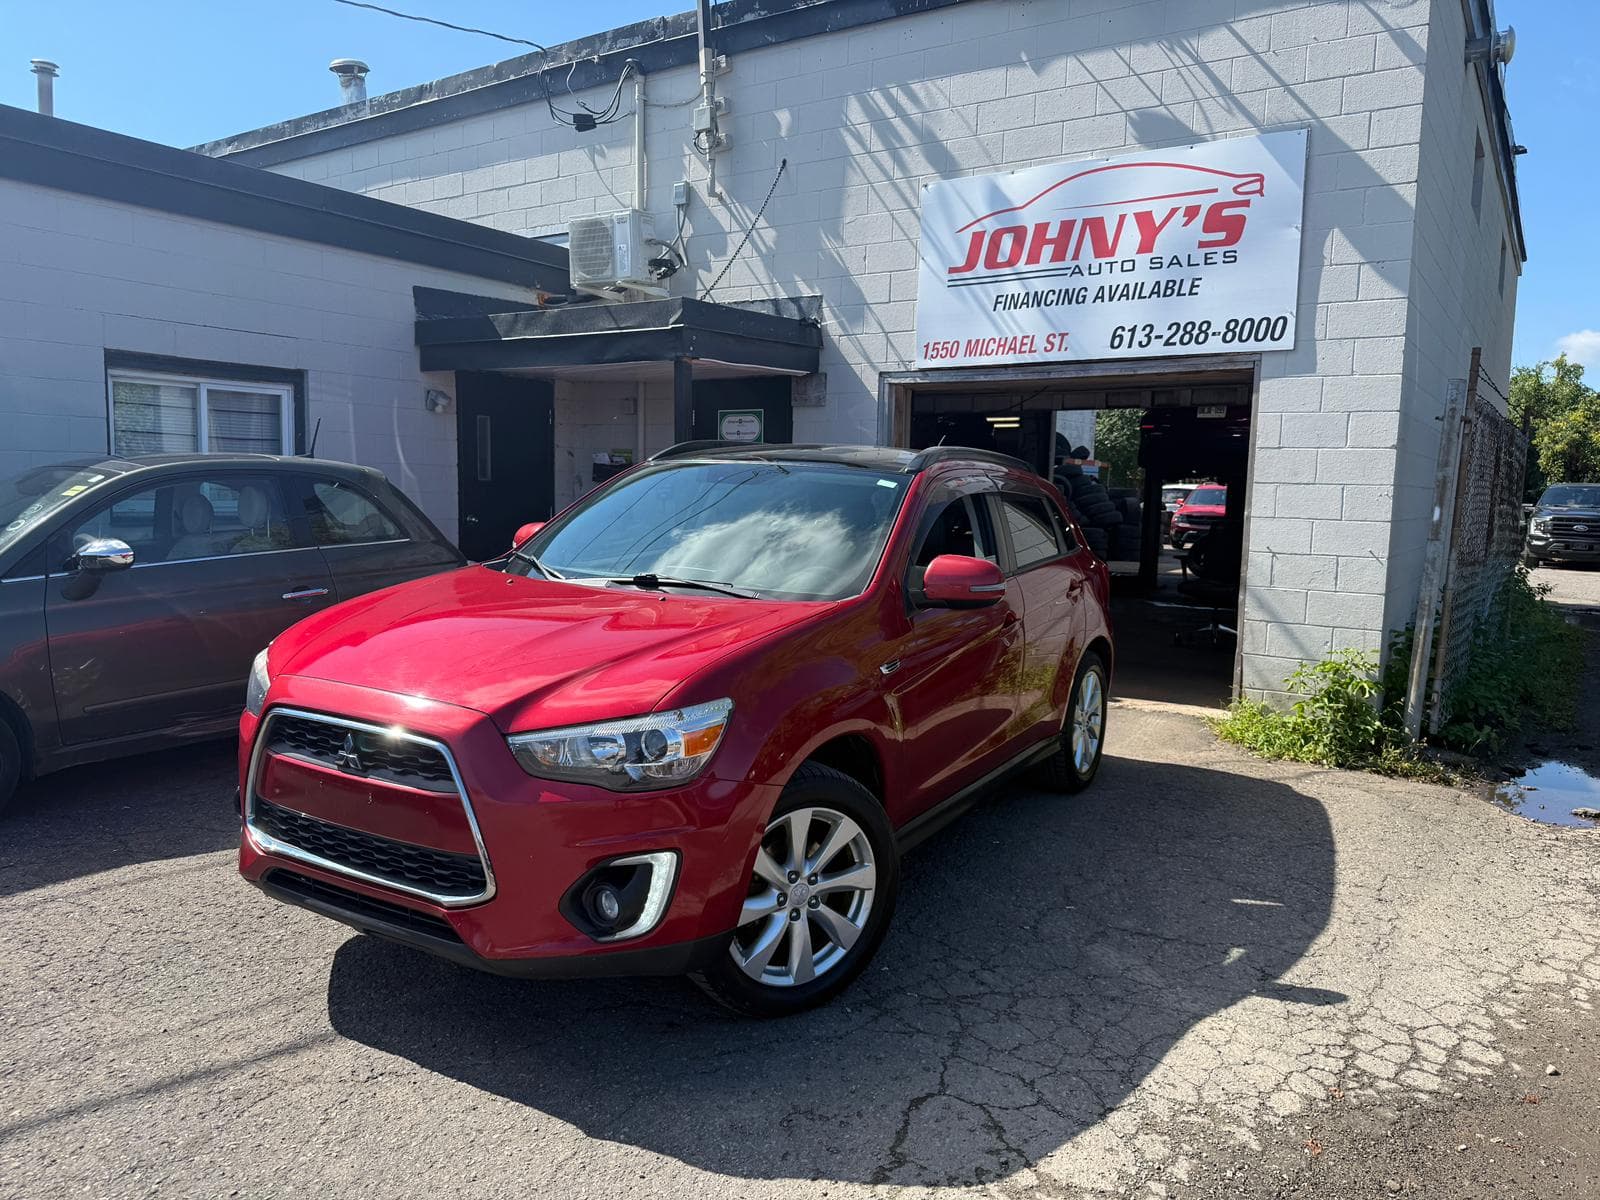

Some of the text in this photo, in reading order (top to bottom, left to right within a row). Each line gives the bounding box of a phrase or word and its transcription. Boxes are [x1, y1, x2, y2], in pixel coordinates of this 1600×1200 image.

[948, 199, 1251, 274] JOHNY'S
[1069, 249, 1239, 278] AUTO SALES
[993, 277, 1202, 312] FINANCING AVAILABLE
[922, 332, 1070, 360] 1550 MICHAEL ST.
[1109, 315, 1288, 350] 613-288-8000
